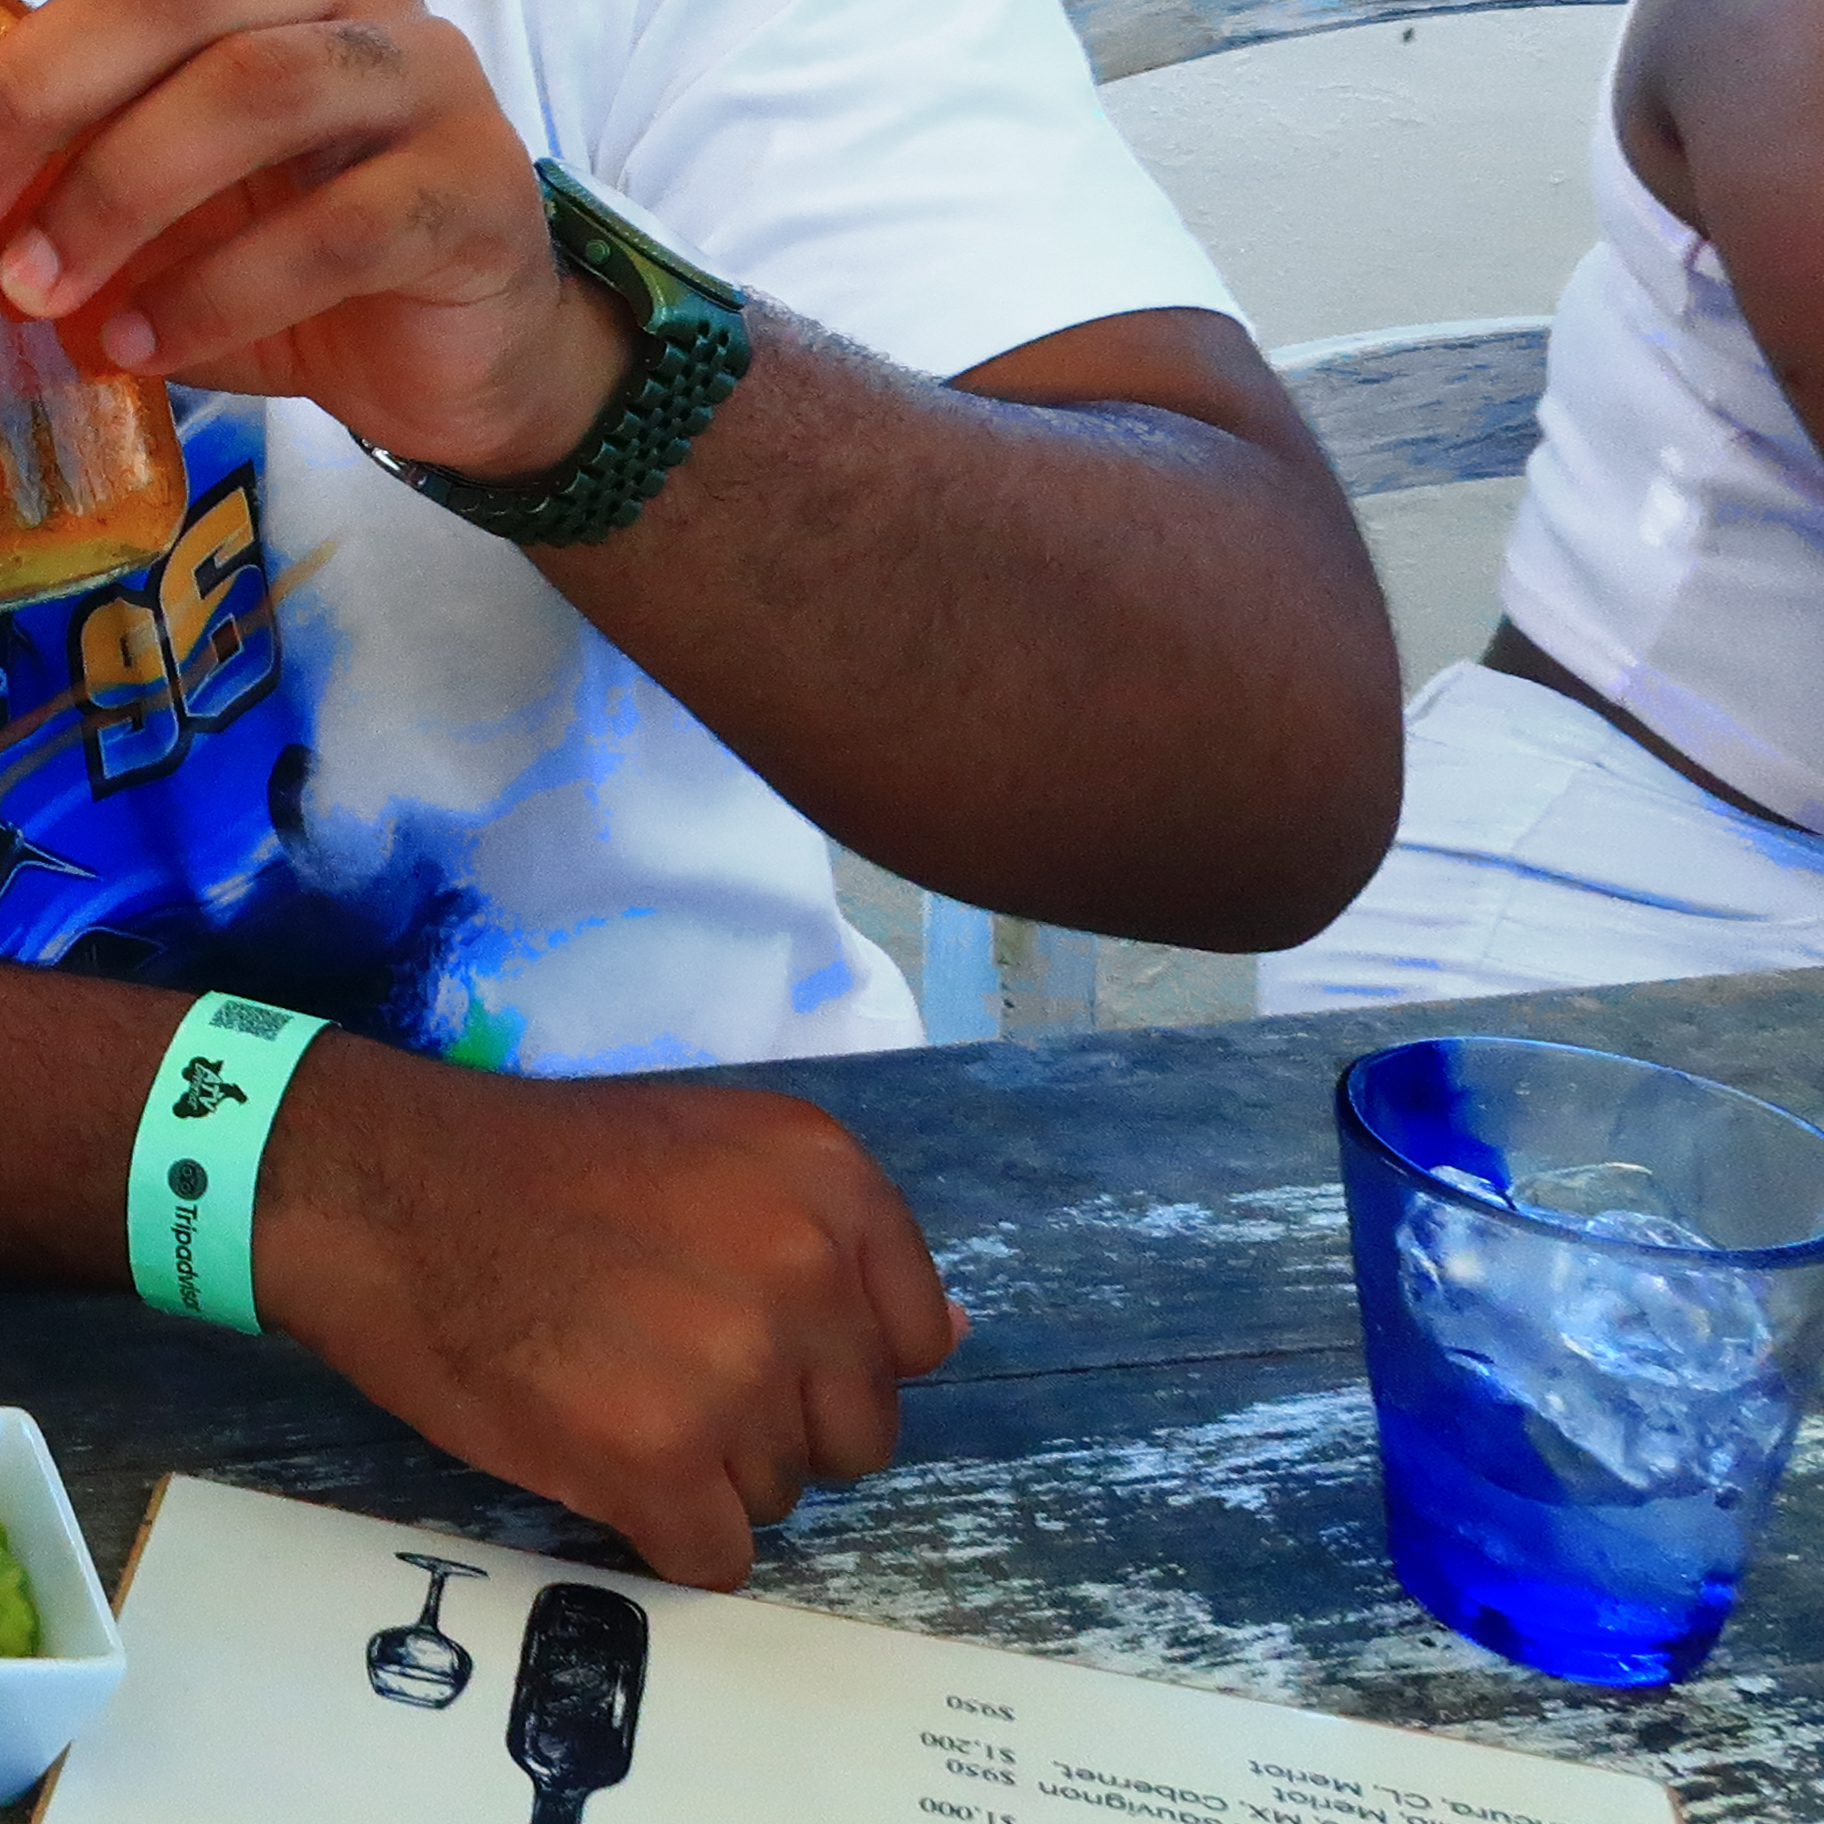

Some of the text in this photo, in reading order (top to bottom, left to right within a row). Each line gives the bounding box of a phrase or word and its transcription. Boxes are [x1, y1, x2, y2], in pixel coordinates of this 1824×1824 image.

[195, 1062, 225, 1113] ATV
[1247, 1759, 1364, 1799] Merlot
[1270, 1786, 1388, 1824] Merlot
